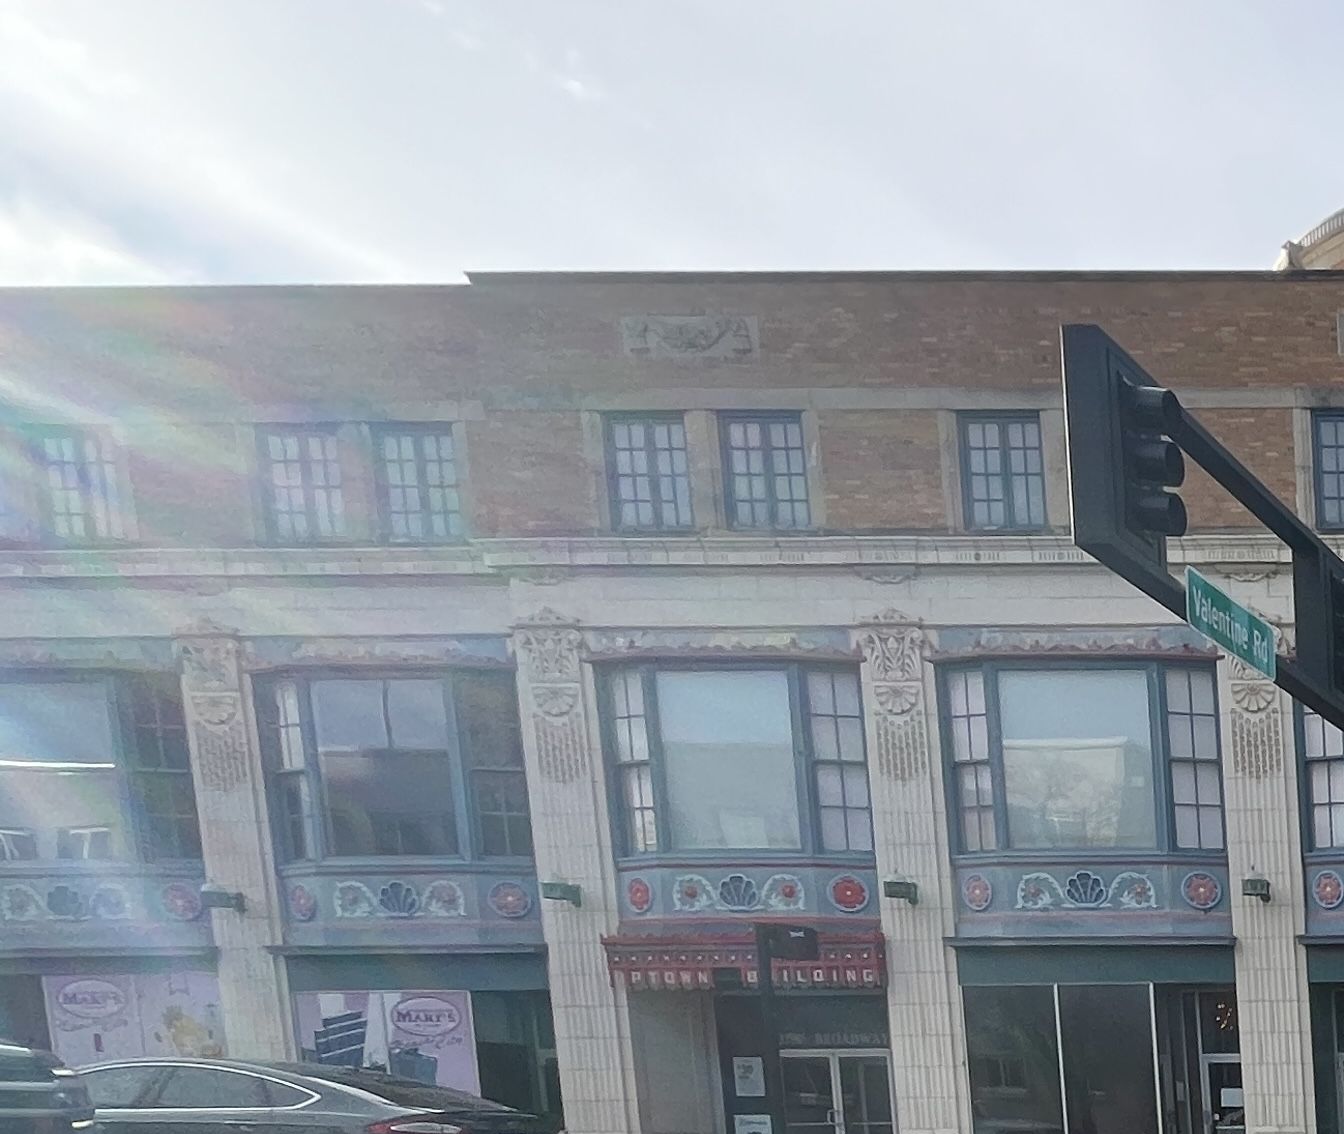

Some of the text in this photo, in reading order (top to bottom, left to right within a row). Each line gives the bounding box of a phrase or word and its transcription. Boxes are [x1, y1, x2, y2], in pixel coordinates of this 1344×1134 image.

[1192, 585, 1268, 663] Valentine Rd
[747, 968, 873, 983] BILDING
